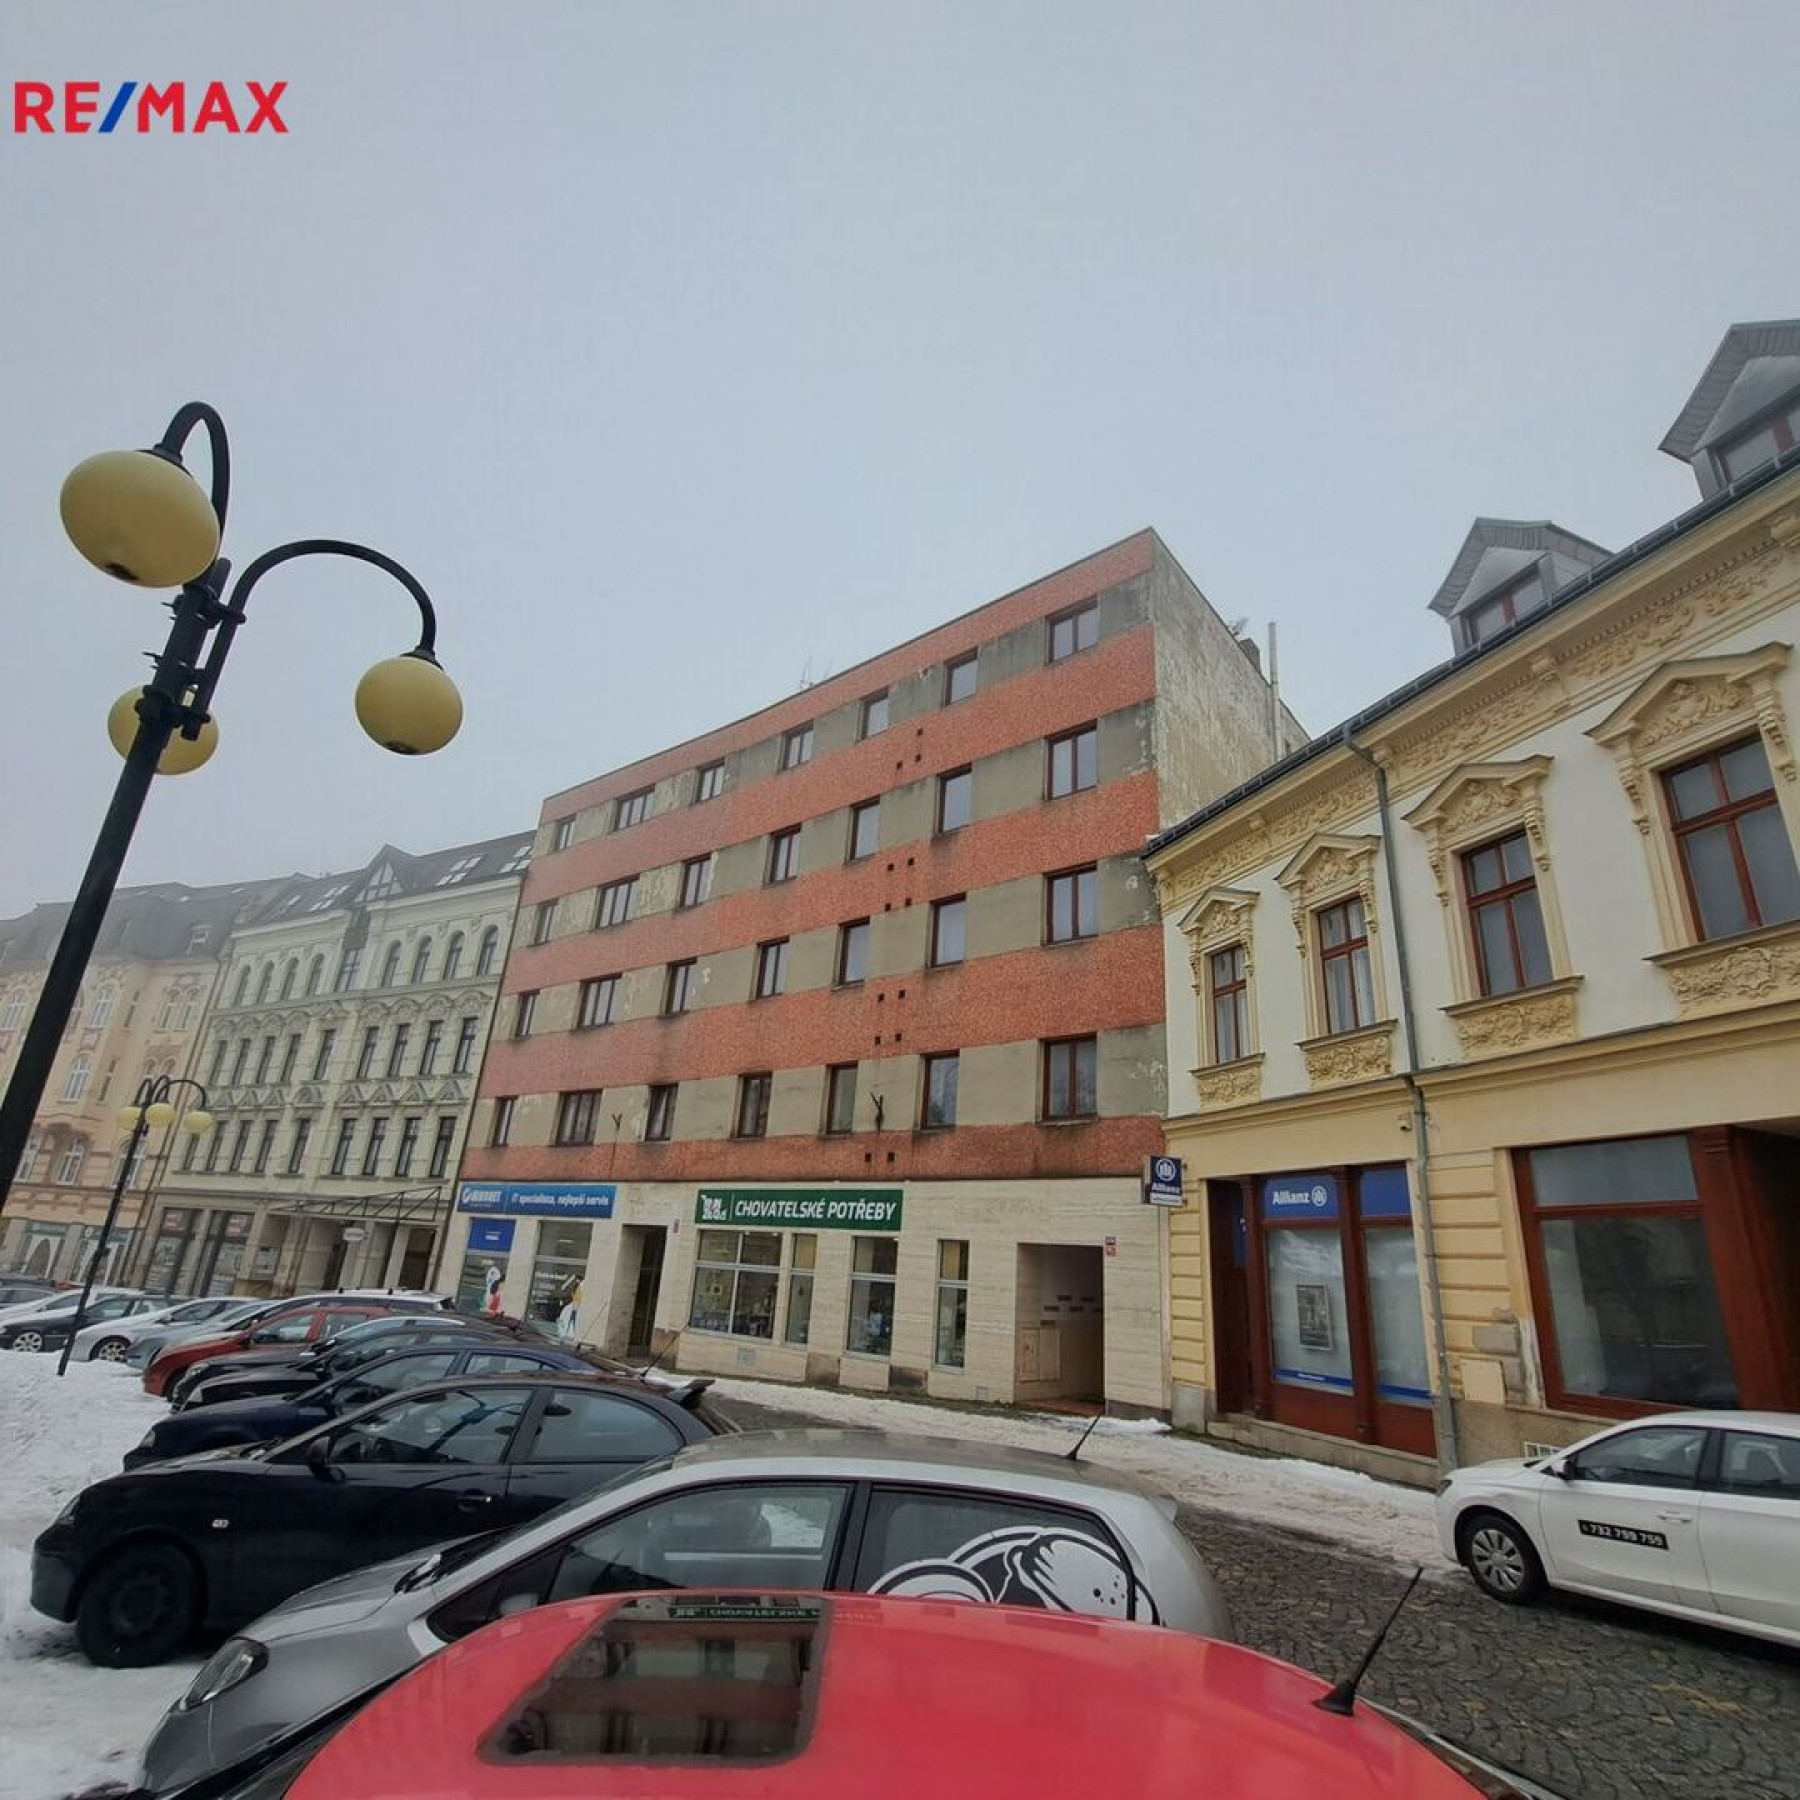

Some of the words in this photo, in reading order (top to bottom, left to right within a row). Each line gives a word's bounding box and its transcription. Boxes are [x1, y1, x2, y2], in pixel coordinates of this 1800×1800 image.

[1151, 1182, 1181, 1194] Allianz
[1272, 1189, 1310, 1205] Allianz
[735, 1197, 826, 1218] CHOVATELSKÉ
[827, 1198, 896, 1221] POTŘEBY
